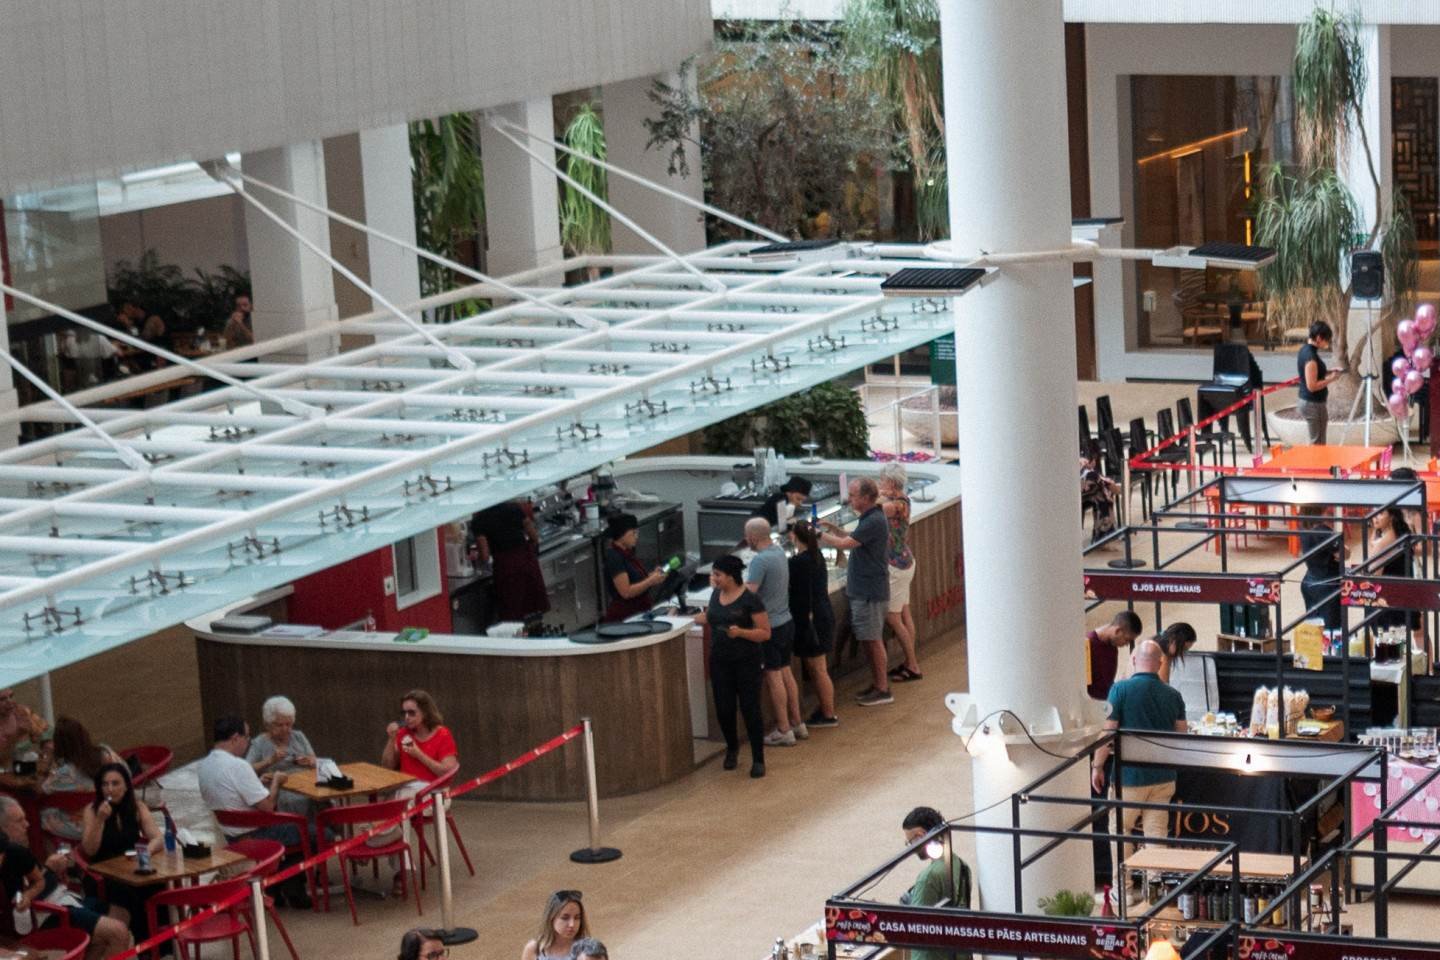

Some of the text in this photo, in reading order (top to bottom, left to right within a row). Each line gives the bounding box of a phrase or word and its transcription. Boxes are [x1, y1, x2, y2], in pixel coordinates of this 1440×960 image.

[1155, 584, 1201, 593] ARTESANAIS
[879, 921, 906, 933] CASA
[908, 923, 943, 936] MENON
[945, 926, 986, 938] MASSAS
[988, 929, 995, 939] E
[997, 928, 1023, 941] PÃES
[1024, 932, 1087, 946] ARTESANAIS
